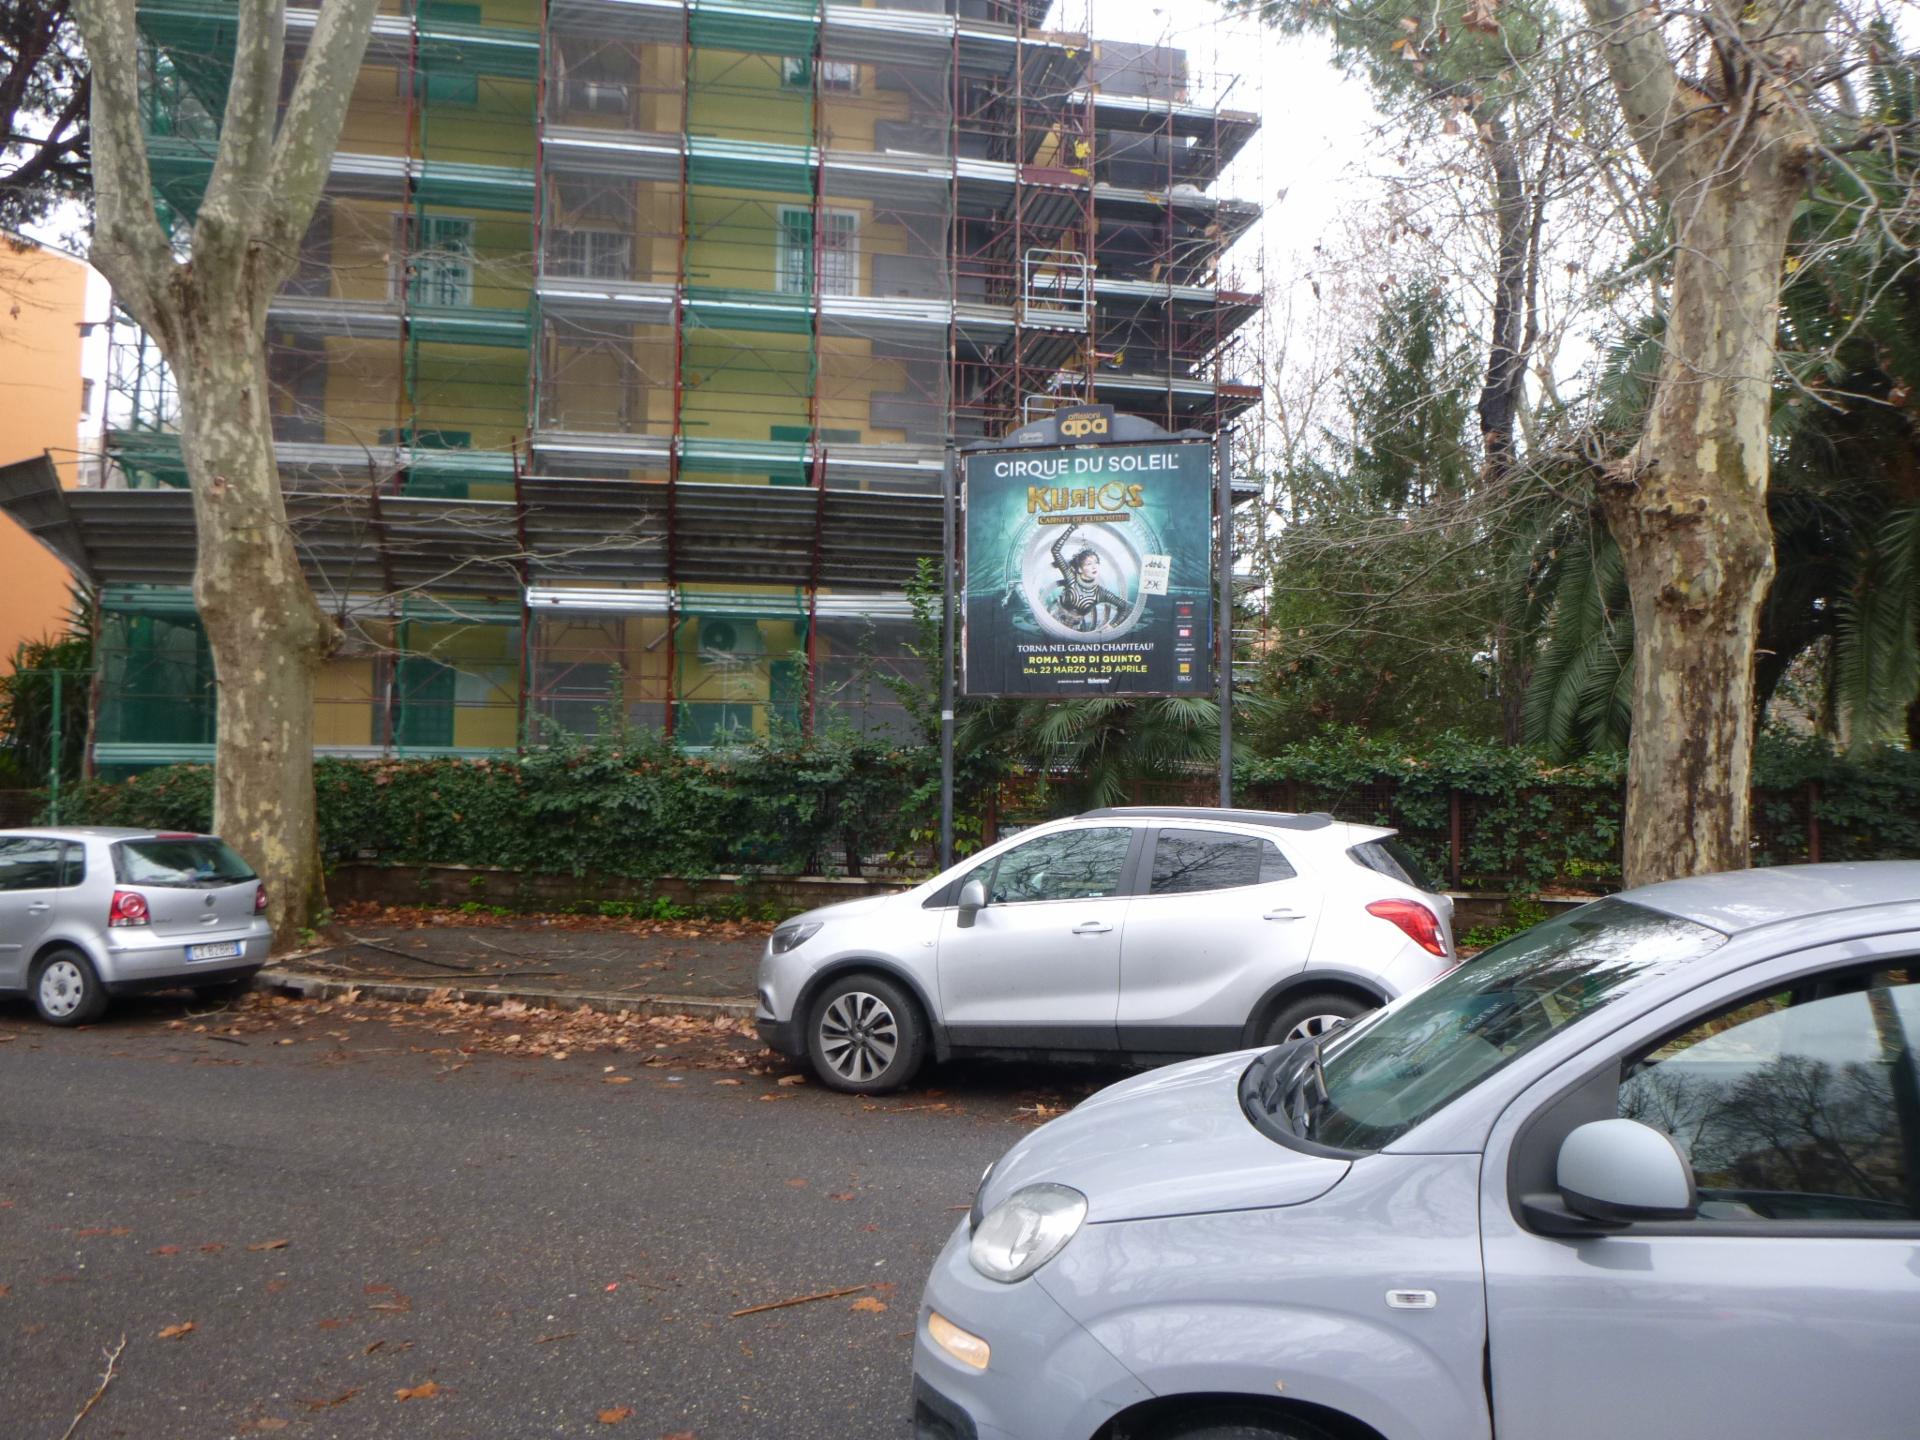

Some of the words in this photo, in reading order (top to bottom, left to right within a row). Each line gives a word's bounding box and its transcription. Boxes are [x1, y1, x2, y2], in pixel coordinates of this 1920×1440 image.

[1061, 418, 1107, 438] apa
[995, 459, 1068, 479] CIRQUE
[1074, 456, 1104, 474] DU
[1017, 644, 1048, 653] TORNA
[1050, 644, 1067, 652] NEL
[1069, 643, 1101, 652] GRAND
[1102, 642, 1154, 652] CHAPITEAU!
[1028, 656, 1059, 664] ROMA
[1065, 655, 1086, 664] TOR
[1088, 655, 1100, 663] DI
[1102, 655, 1142, 663] QUINTO
[1040, 666, 1051, 674] 22
[1053, 665, 1087, 674] MARZO
[1100, 665, 1112, 673] 29
[1115, 664, 1148, 673] APRILE
